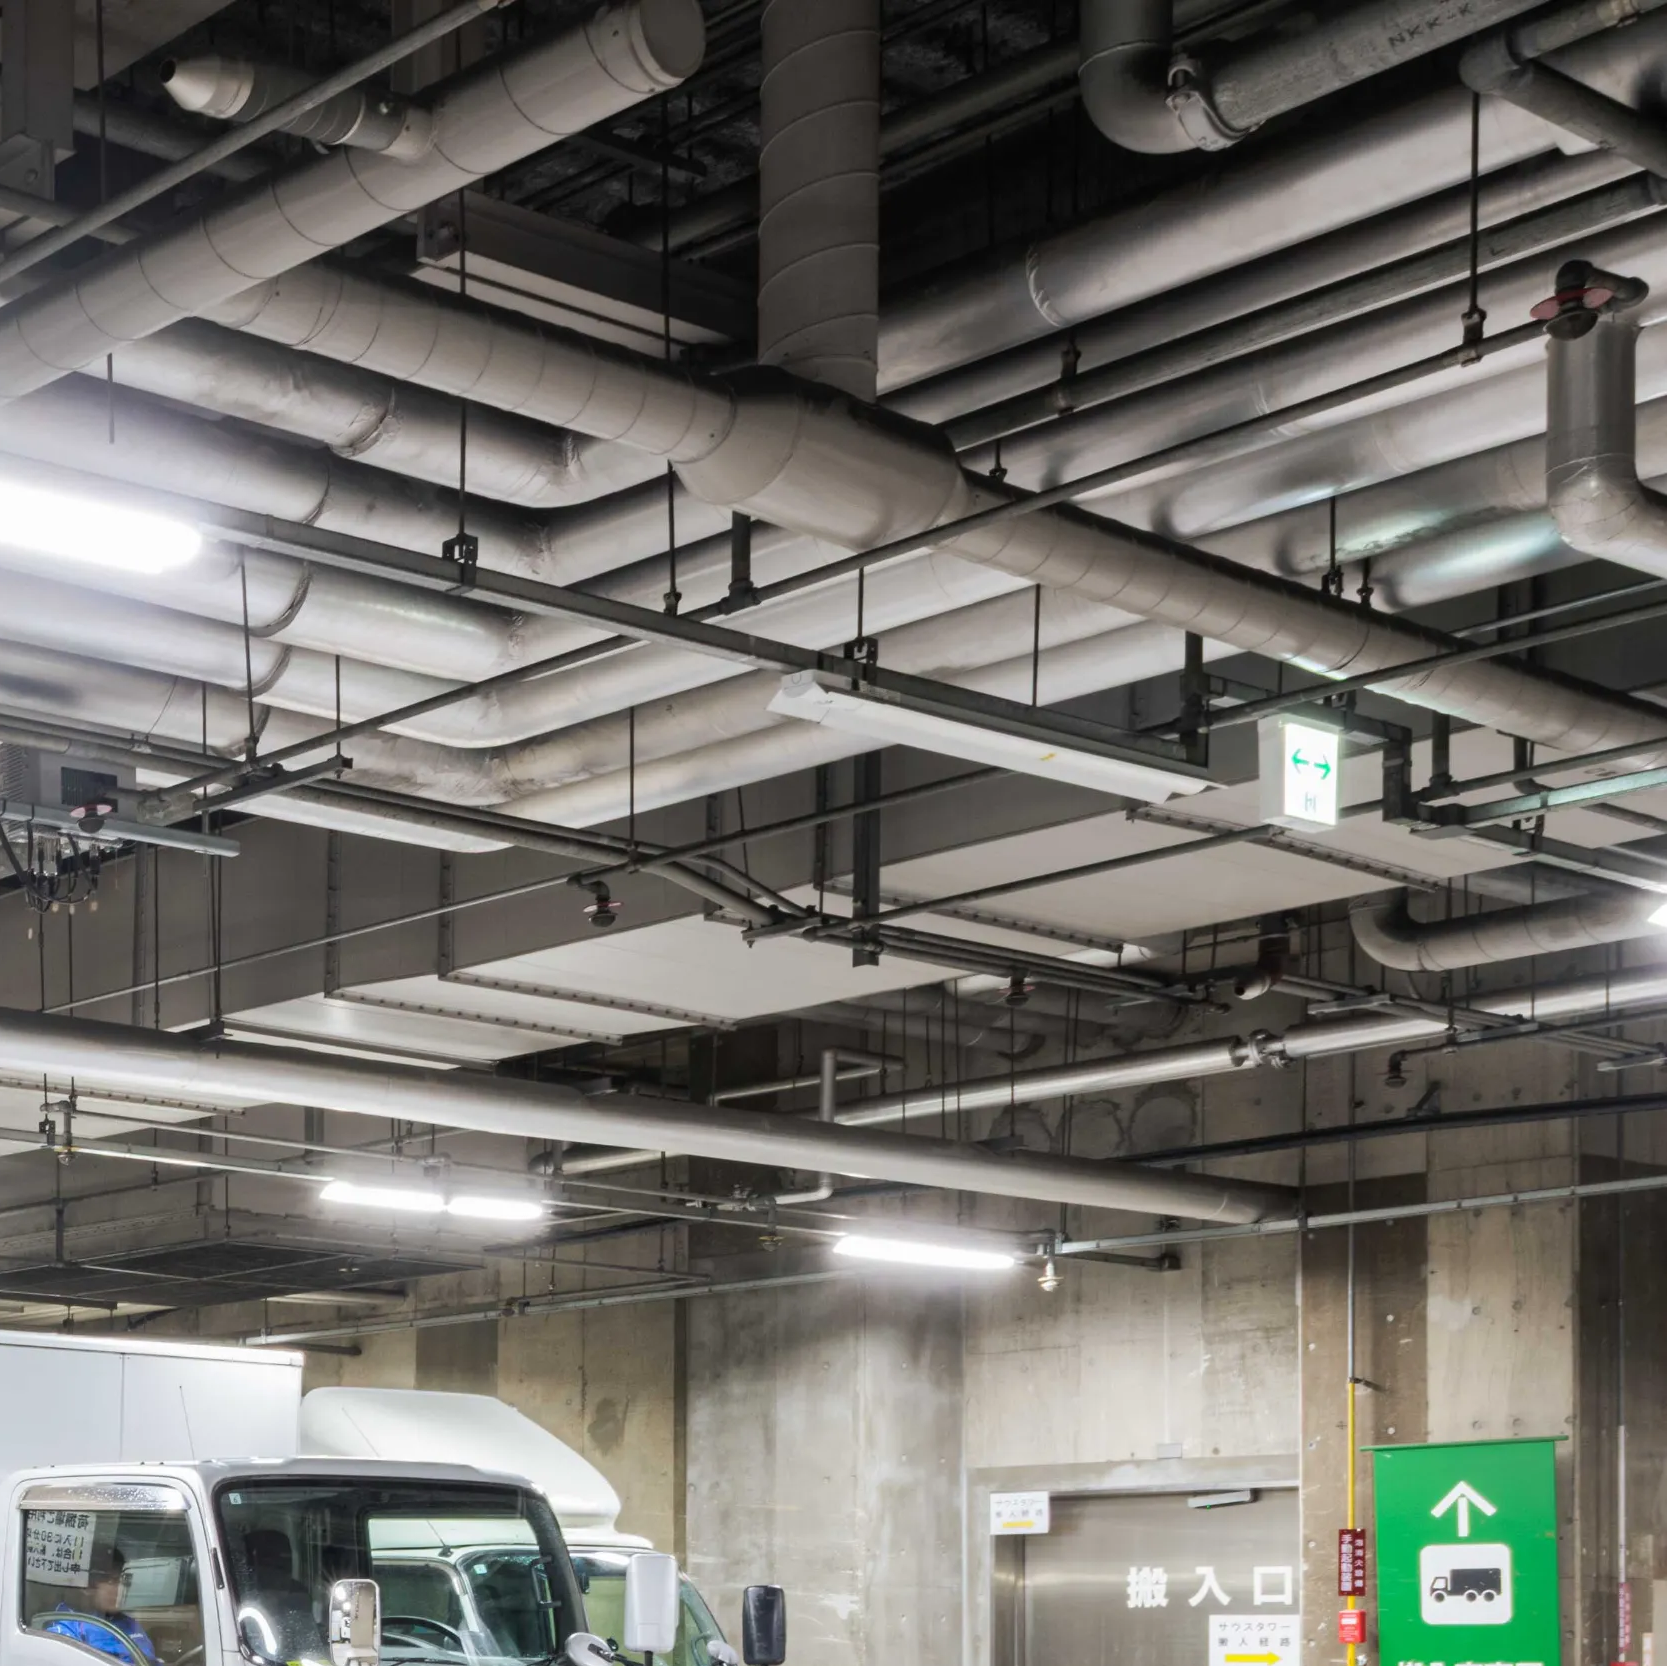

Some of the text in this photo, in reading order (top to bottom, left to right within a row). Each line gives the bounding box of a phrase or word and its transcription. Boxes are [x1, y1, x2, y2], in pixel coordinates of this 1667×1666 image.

[1126, 1565, 1293, 1608] 搬入口
[1219, 1622, 1291, 1632] サウスタワー
